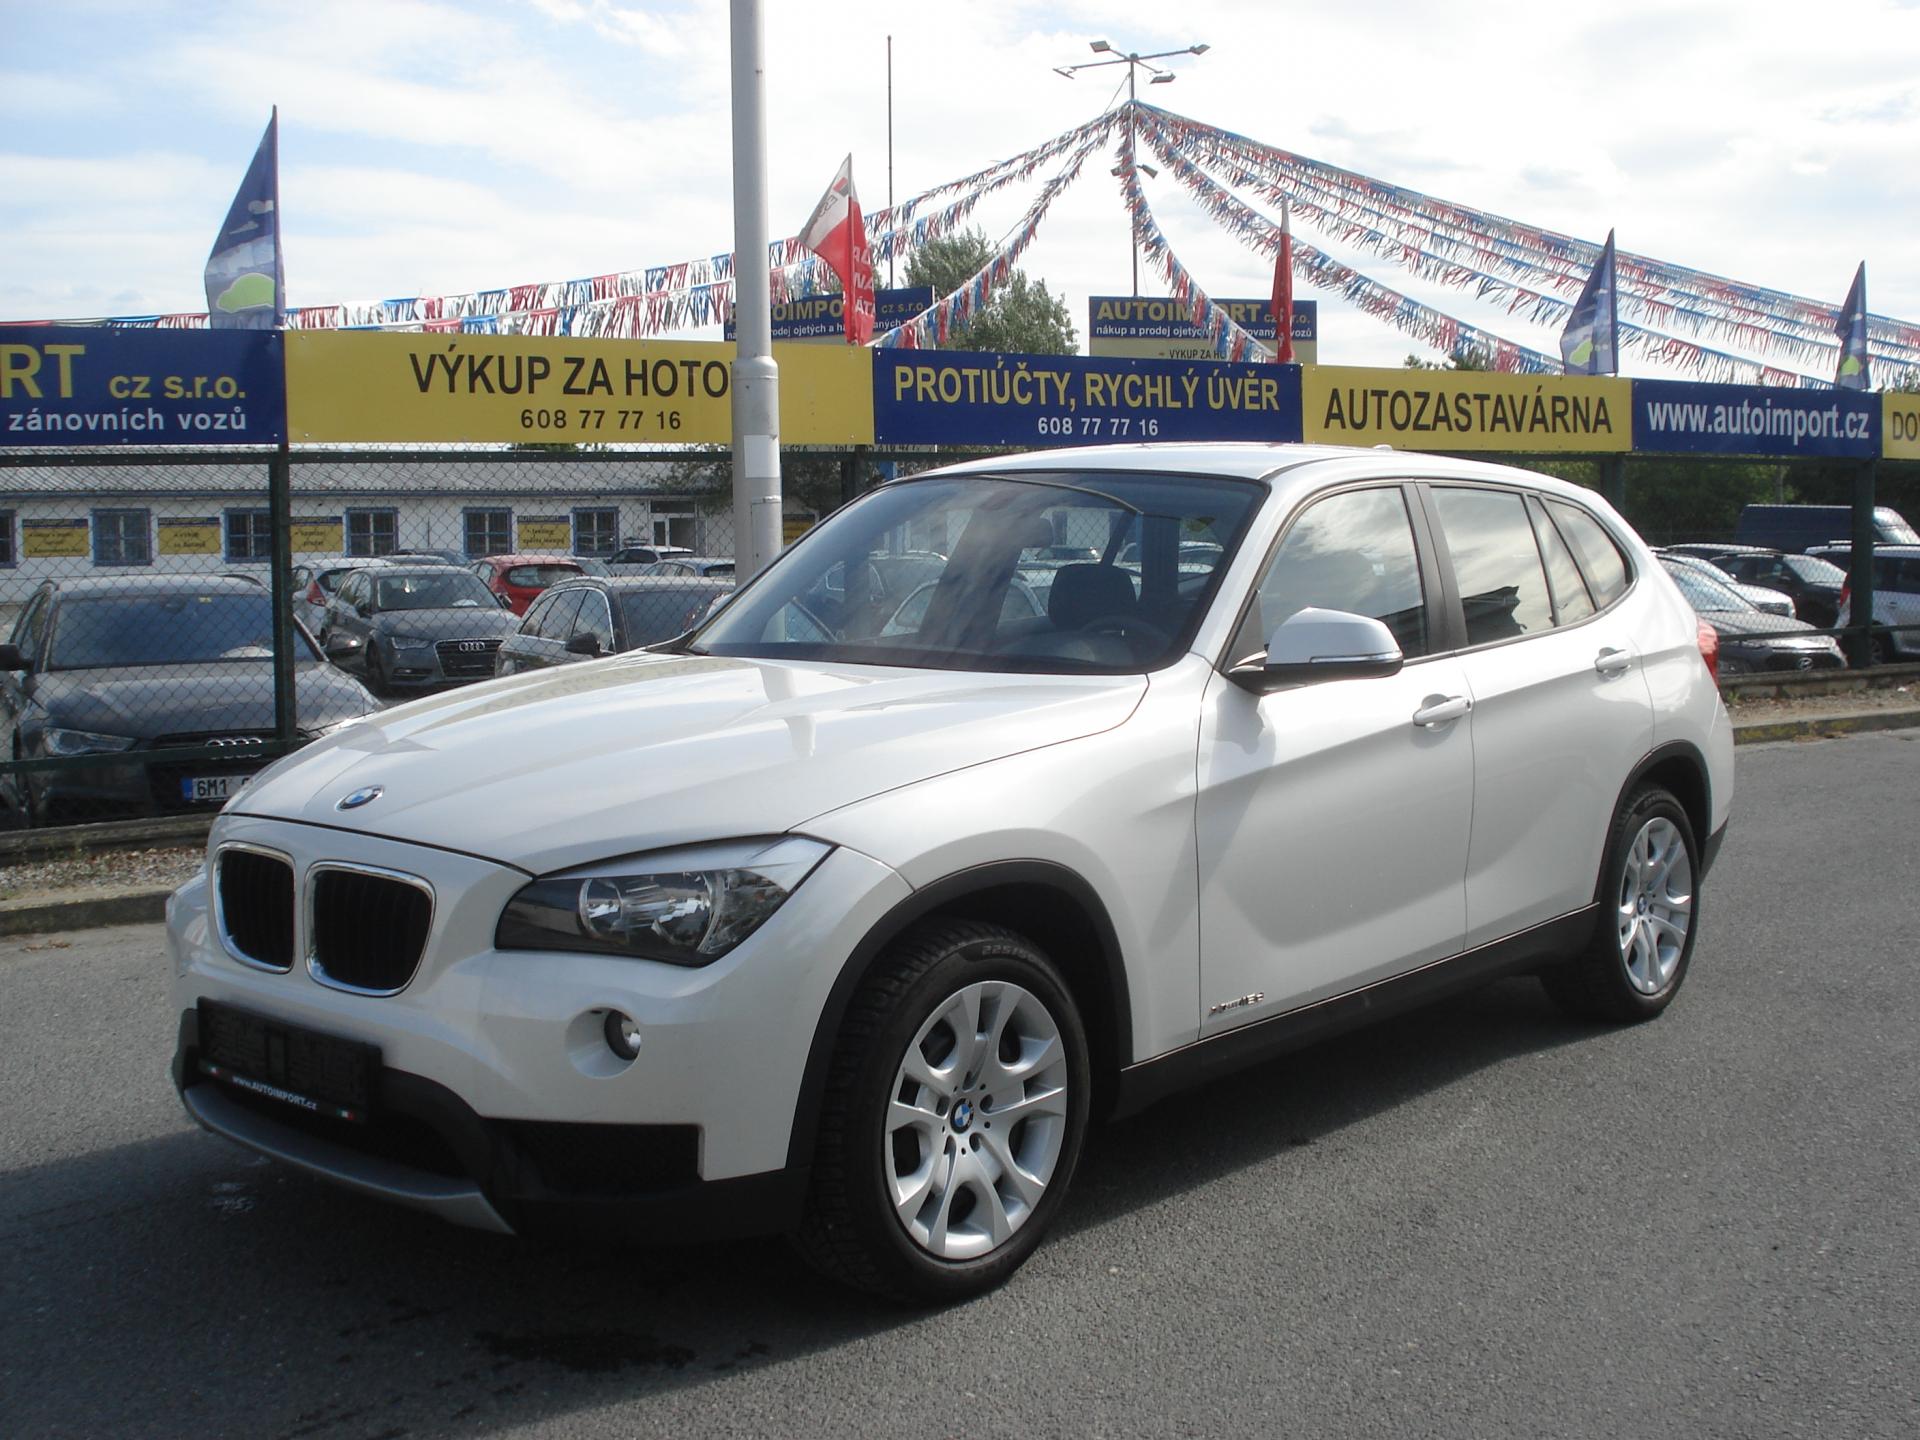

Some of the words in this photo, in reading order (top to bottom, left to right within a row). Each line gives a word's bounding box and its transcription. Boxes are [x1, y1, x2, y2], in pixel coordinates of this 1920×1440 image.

[1096, 324, 1127, 337] nákup
[1130, 327, 1136, 335] a
[1138, 325, 1171, 337] prodej
[409, 344, 550, 395] VÝKUP
[563, 357, 614, 396] ZA
[625, 358, 732, 398] HOTO
[109, 375, 152, 399] cz
[163, 376, 246, 399] s.r.o.
[895, 361, 1076, 412] PROTIÚČTY,
[1085, 368, 1199, 409] RYCHLÝ
[1207, 369, 1280, 411] ÚVĚR
[9, 407, 164, 431] zánovních
[177, 406, 246, 430] vozů
[521, 409, 567, 429] 608
[579, 410, 605, 429] 77
[617, 411, 644, 430] 77
[656, 411, 681, 430] 16
[1324, 386, 1613, 434] AUTOZASTAVÁRNA
[1647, 399, 1870, 445] www.autoimport.cz
[1037, 417, 1073, 435] 608
[1081, 418, 1102, 436] 77
[1110, 418, 1130, 436] 77
[1139, 419, 1159, 436] 16
[1892, 411, 1920, 442] DO
[197, 779, 227, 796] 6M1
